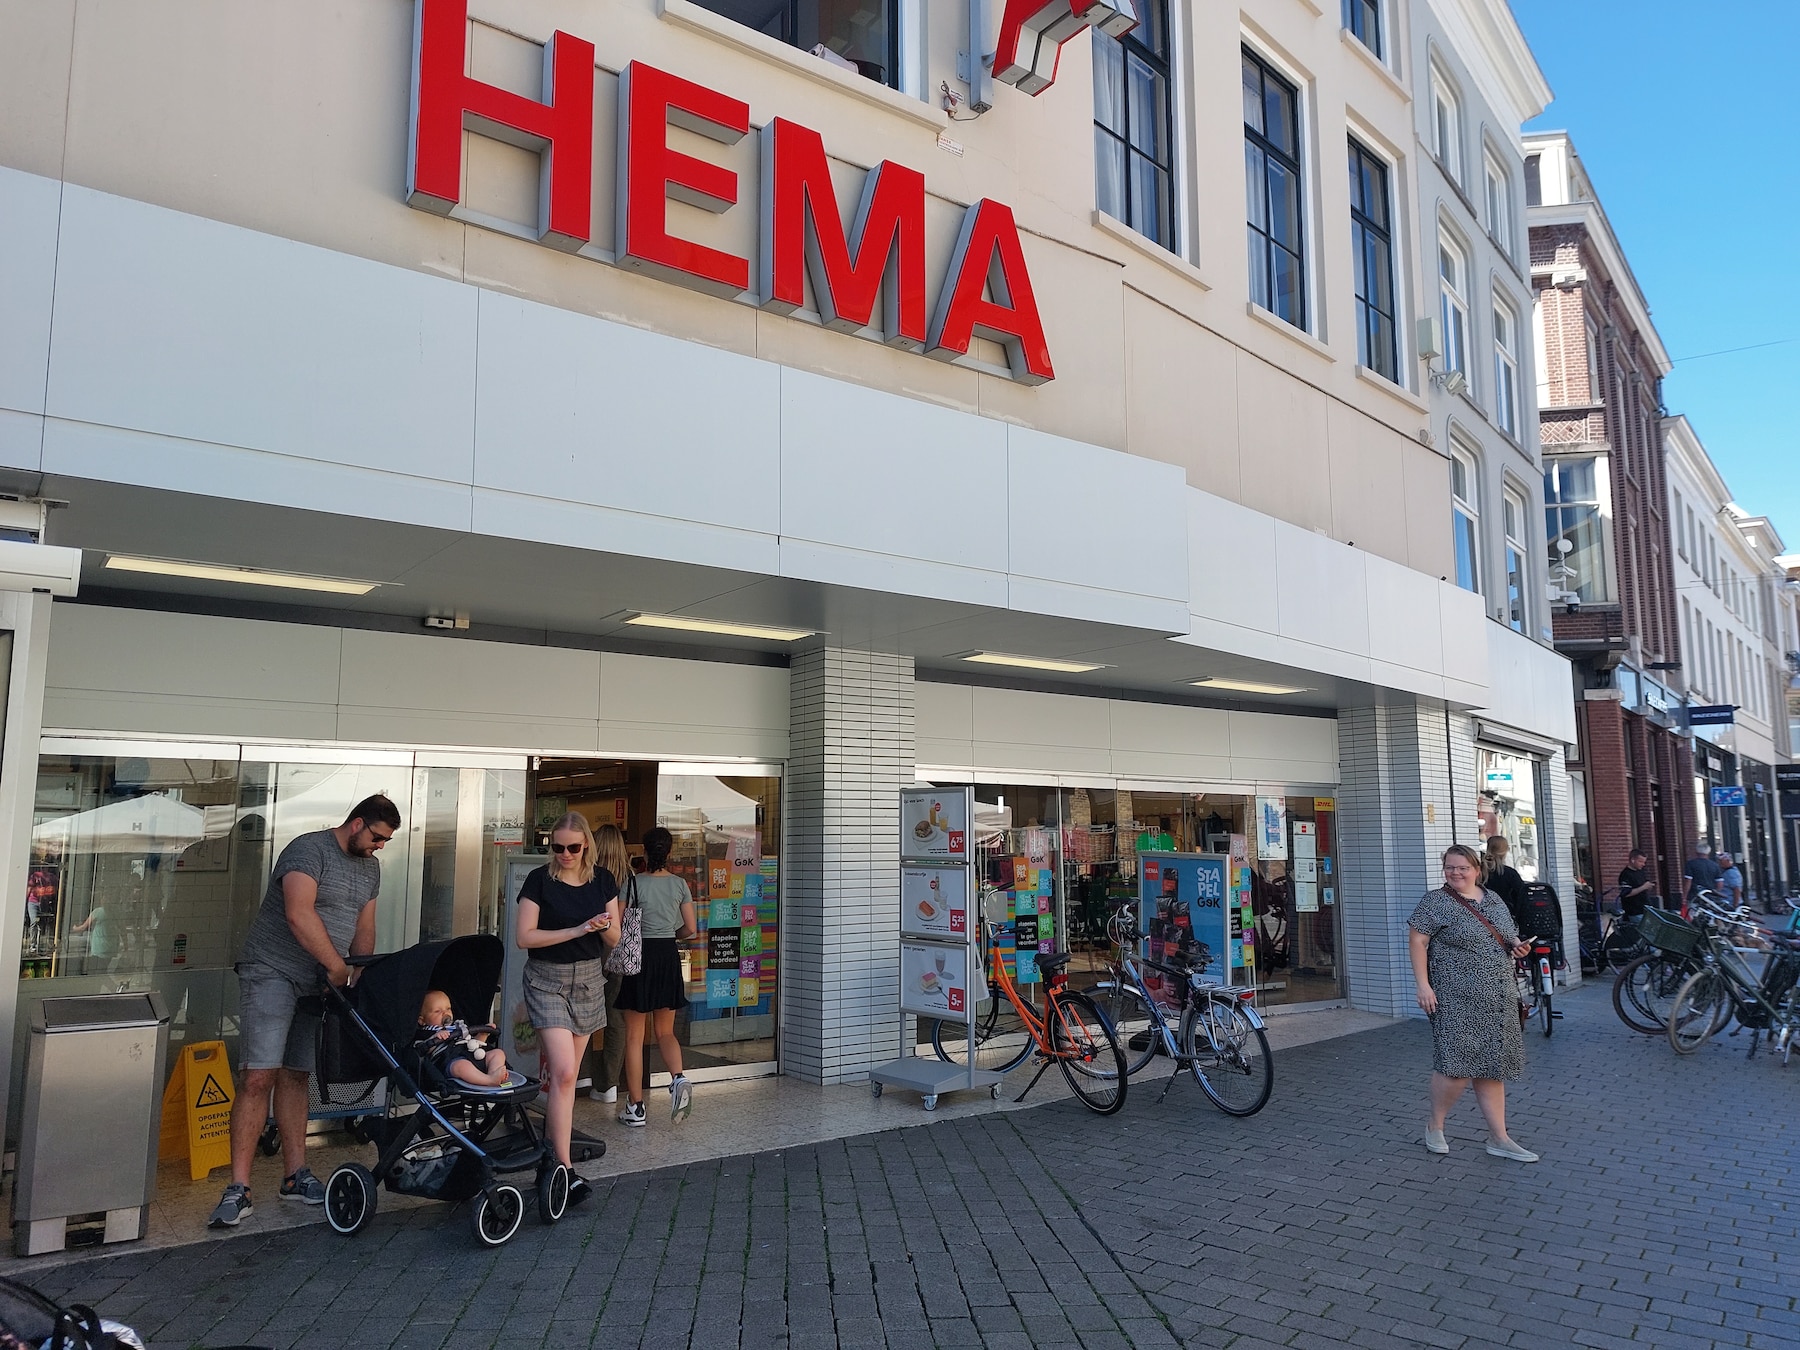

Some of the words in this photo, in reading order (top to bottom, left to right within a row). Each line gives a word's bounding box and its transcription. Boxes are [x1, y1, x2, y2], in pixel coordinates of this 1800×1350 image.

[407, 0, 1055, 386] HEMA
[1196, 866, 1221, 884] STA
[1197, 881, 1220, 898] PEL
[722, 949, 735, 957] gek
[198, 1111, 232, 1122] OPGEPAST
[199, 1128, 231, 1141] ATTENTIO
